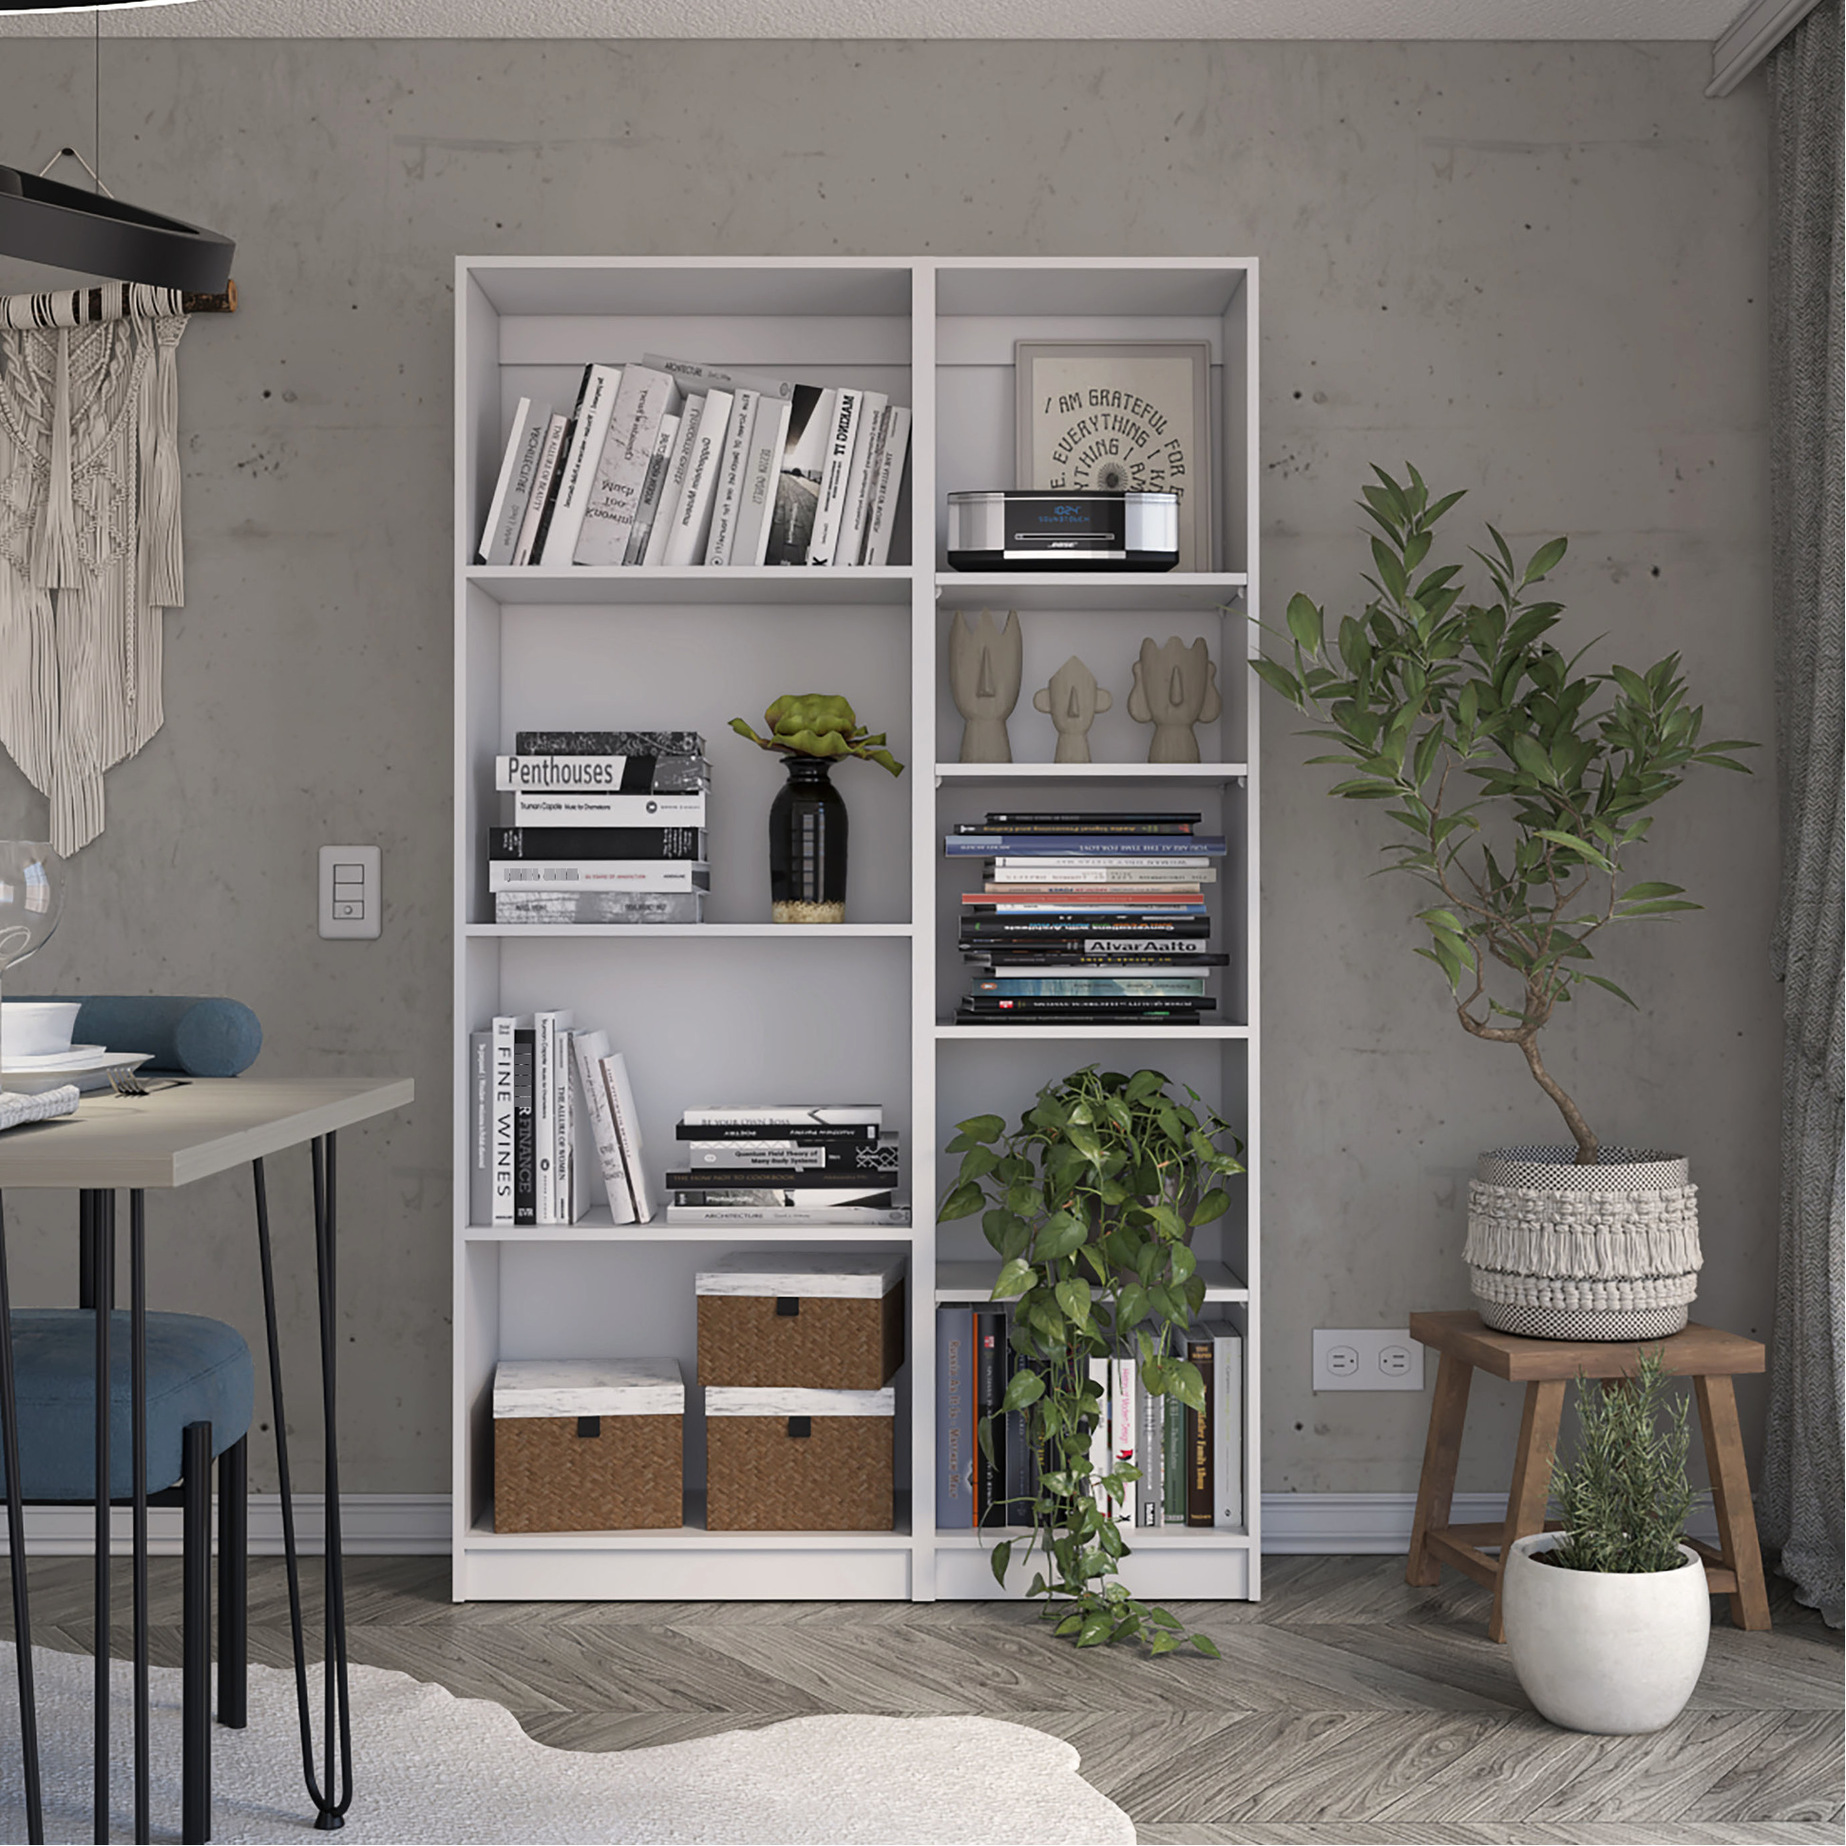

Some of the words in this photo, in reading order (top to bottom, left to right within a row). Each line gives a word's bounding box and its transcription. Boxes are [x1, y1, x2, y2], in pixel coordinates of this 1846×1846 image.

[1044, 397, 1052, 414] I
[1058, 392, 1082, 413] AM
[1089, 388, 1167, 436] GRATEFUL
[1164, 438, 1186, 477] FOR
[1052, 413, 1150, 465] EVERYTHING
[508, 757, 613, 787] Penthouses
[497, 1046, 510, 1101] FINE
[497, 1113, 510, 1198] WINES
[519, 1117, 531, 1193] FINANCE
[948, 1340, 960, 1376] Russia
[948, 1378, 960, 1392] As
[948, 1395, 960, 1404] It
